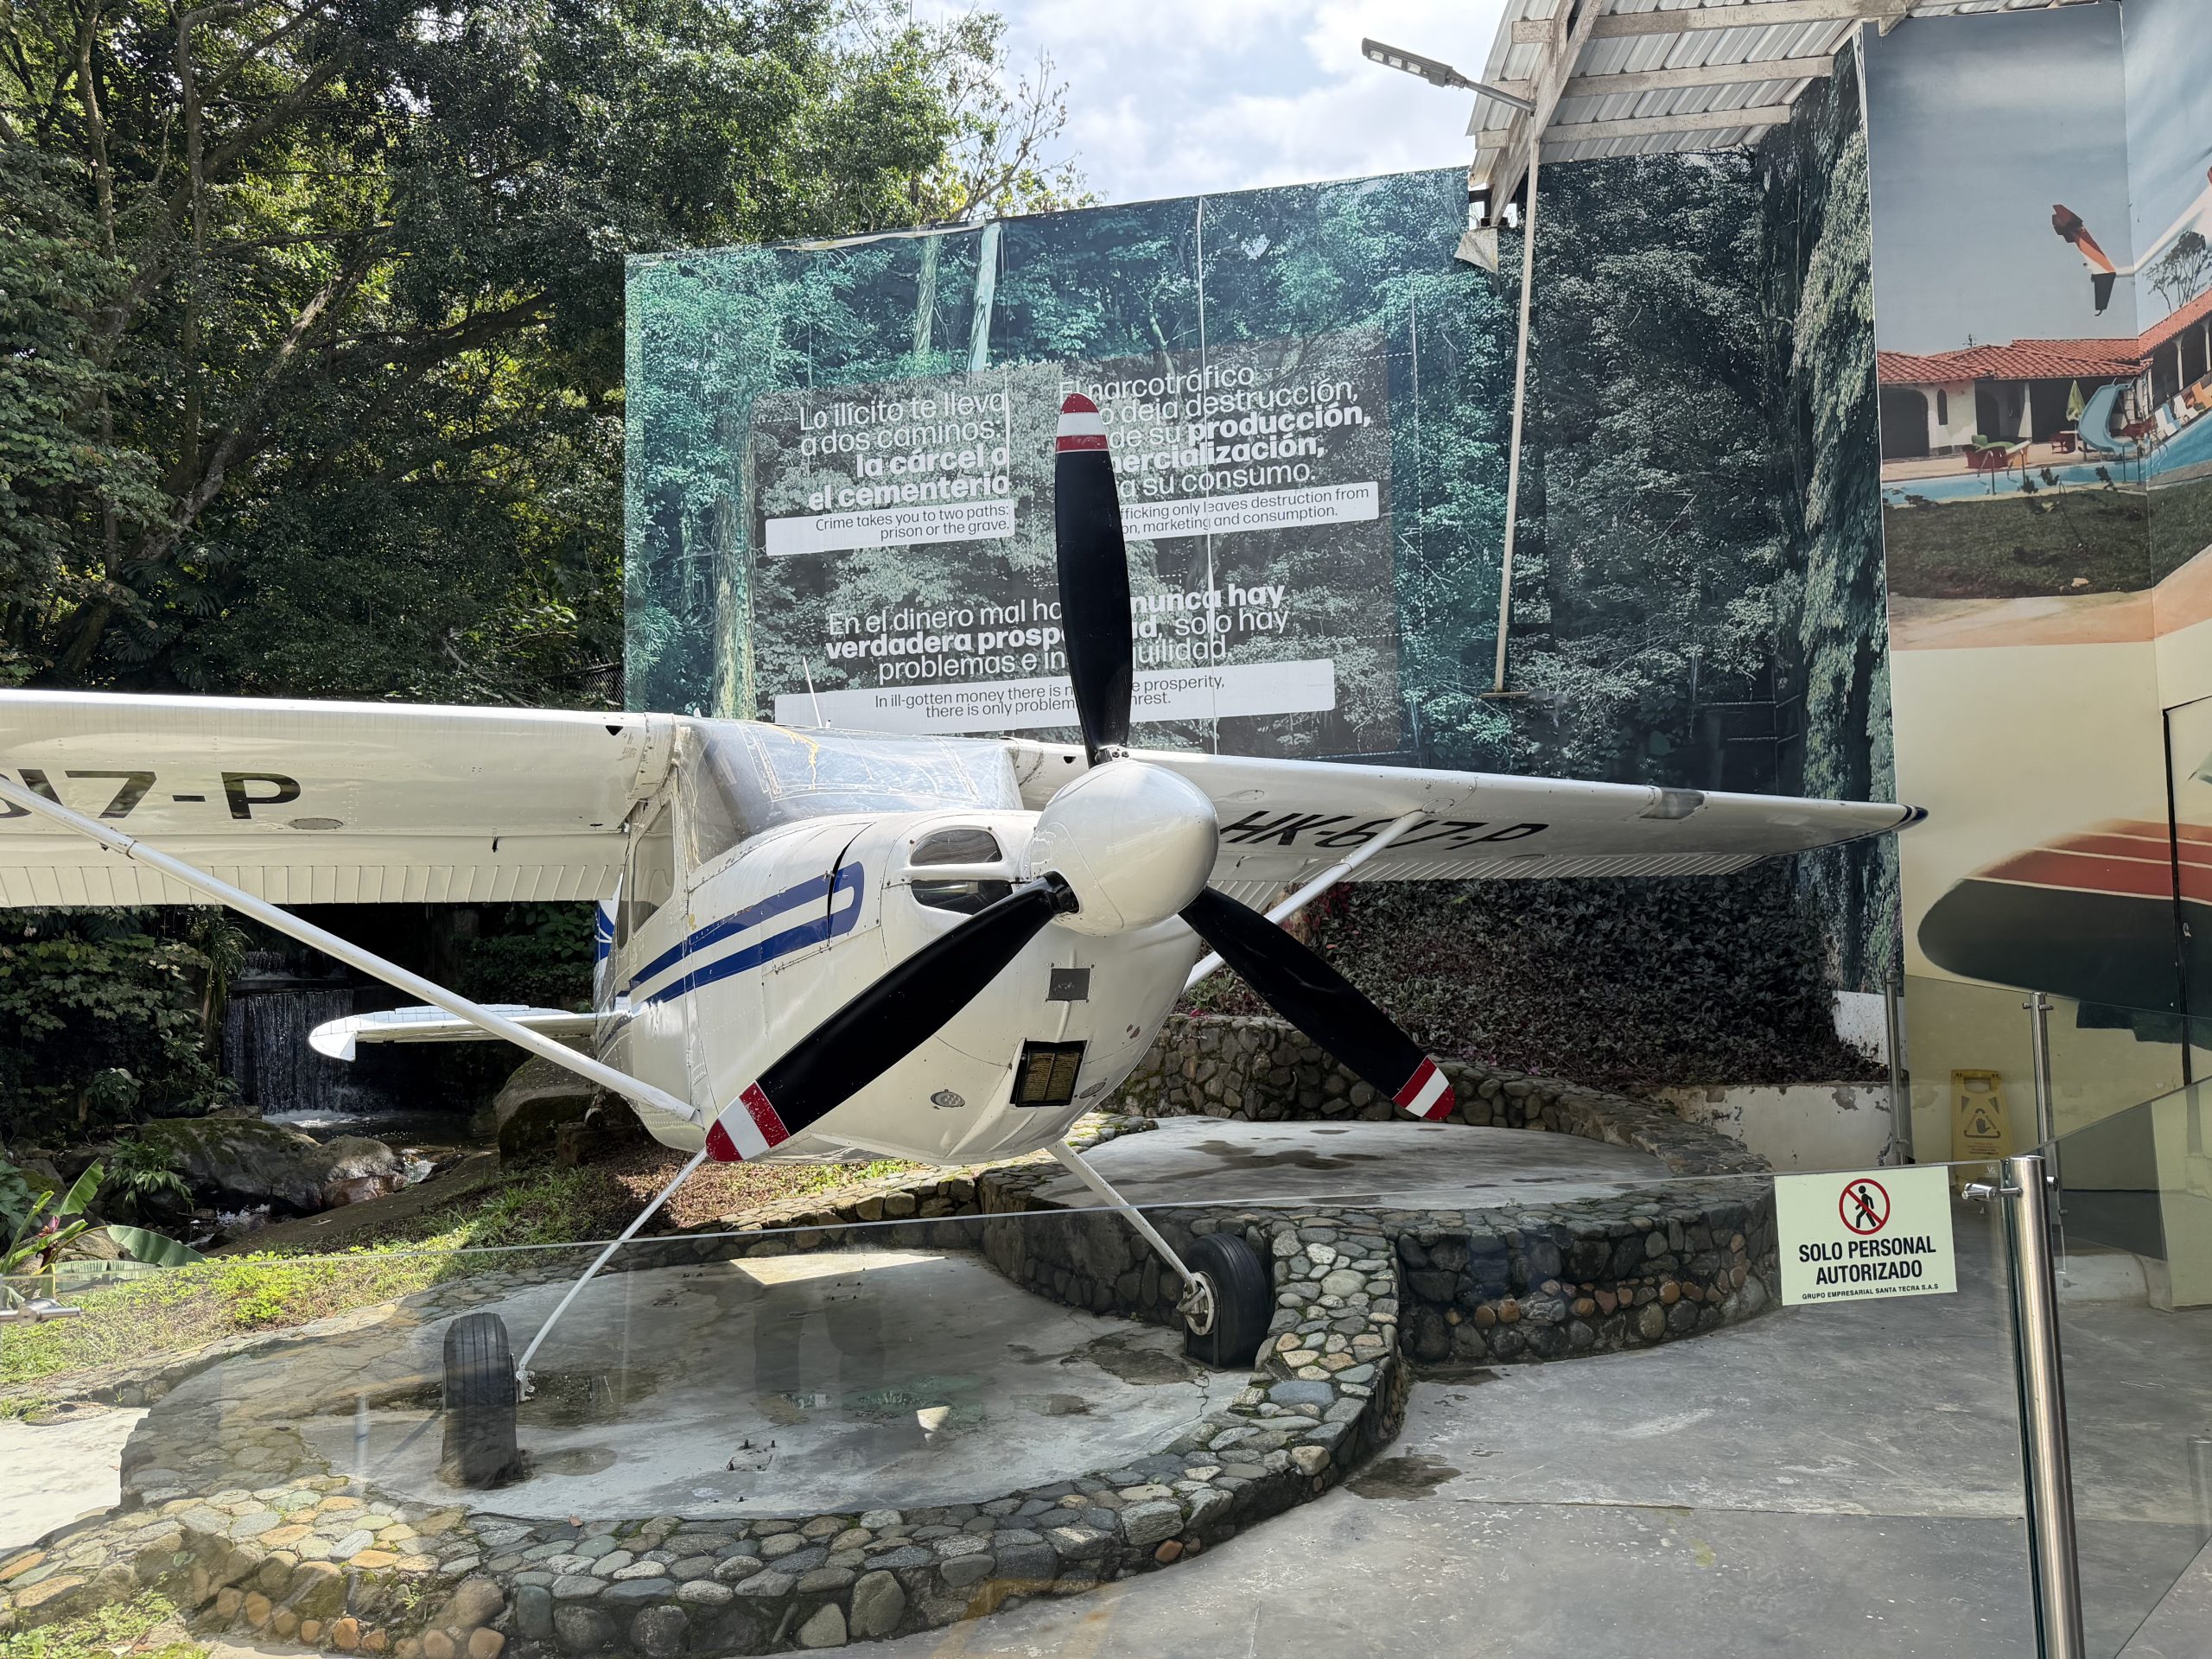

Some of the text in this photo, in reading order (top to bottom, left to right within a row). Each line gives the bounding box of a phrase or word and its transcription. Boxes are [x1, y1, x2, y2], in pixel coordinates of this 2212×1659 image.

[1088, 365, 1255, 399] narcotráfico
[800, 391, 1006, 431] Lo ilícito te lleva
[1122, 399, 1179, 427] deja
[1185, 378, 1357, 415] destrucción,
[800, 420, 1002, 457] a dos caminos:
[1150, 424, 1181, 446] su
[1189, 401, 1371, 447] producción,
[856, 444, 1009, 479] la cárcel o
[1113, 433, 1325, 474] ercialización,
[809, 474, 1009, 512] el cementerio
[1142, 476, 1175, 497] su
[1181, 462, 1317, 493] consumo.
[816, 504, 1009, 532] Crime takes you to two paths:
[1121, 486, 1369, 522] fficking only leaves destruction from
[1142, 516, 1211, 534] marketing
[1213, 512, 1240, 526] and
[1243, 505, 1338, 525] consumption.
[880, 520, 1010, 542] prison or the grave.
[829, 613, 860, 636] En
[866, 608, 887, 633] el
[893, 606, 974, 631] dinero
[981, 599, 1026, 624] mal
[1131, 589, 1221, 614] nunca
[1228, 582, 1286, 607] hay
[826, 631, 972, 660] verdadera
[1174, 610, 1232, 637] solo
[1239, 607, 1290, 634] hay
[878, 651, 1015, 685] problemas
[1021, 652, 1037, 672] e
[875, 695, 887, 708] In
[890, 690, 953, 710] ill-gotten
[956, 692, 1005, 707] money
[1007, 684, 1046, 700] there
[1049, 683, 1061, 697] is
[1144, 674, 1225, 693] prosperity,
[925, 692, 1172, 719] there is only problem nrest.
[1799, 1236, 1936, 1262] SOLO PERSONAL
[1815, 1259, 1923, 1285] AUTORIZADO
[1827, 1289, 1874, 1298] EMPRESARIAL
